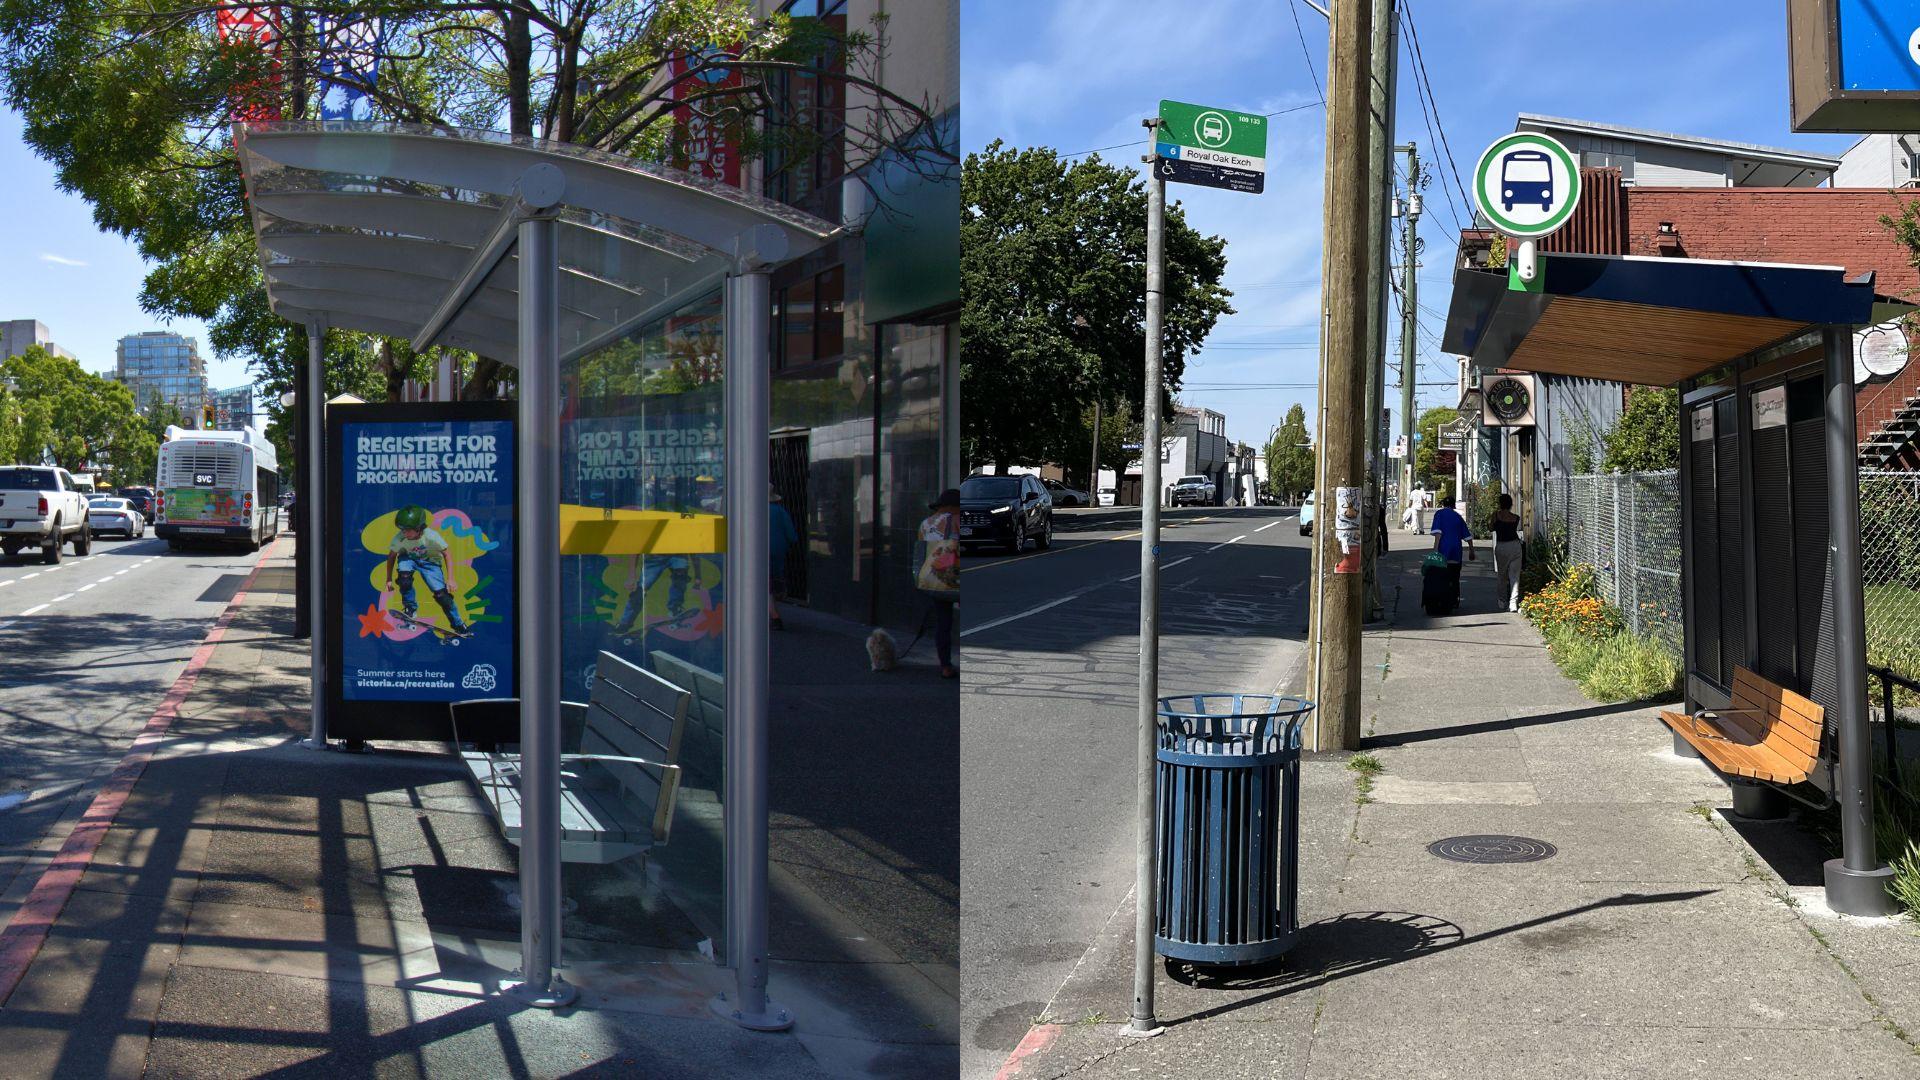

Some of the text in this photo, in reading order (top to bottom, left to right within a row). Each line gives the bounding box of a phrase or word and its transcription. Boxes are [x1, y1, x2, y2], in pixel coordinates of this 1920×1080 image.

[1170, 147, 1176, 155] 6
[1187, 150, 1251, 167] Royal Oak Exch
[357, 435, 496, 453] REGISTER FOR
[356, 452, 497, 471] SUMMER CAMP
[196, 475, 212, 483] SVC
[356, 469, 498, 484] PROGRAMS TODAY.
[357, 669, 445, 678] Summer starts here
[357, 678, 455, 689] victoria.ca/recreation
